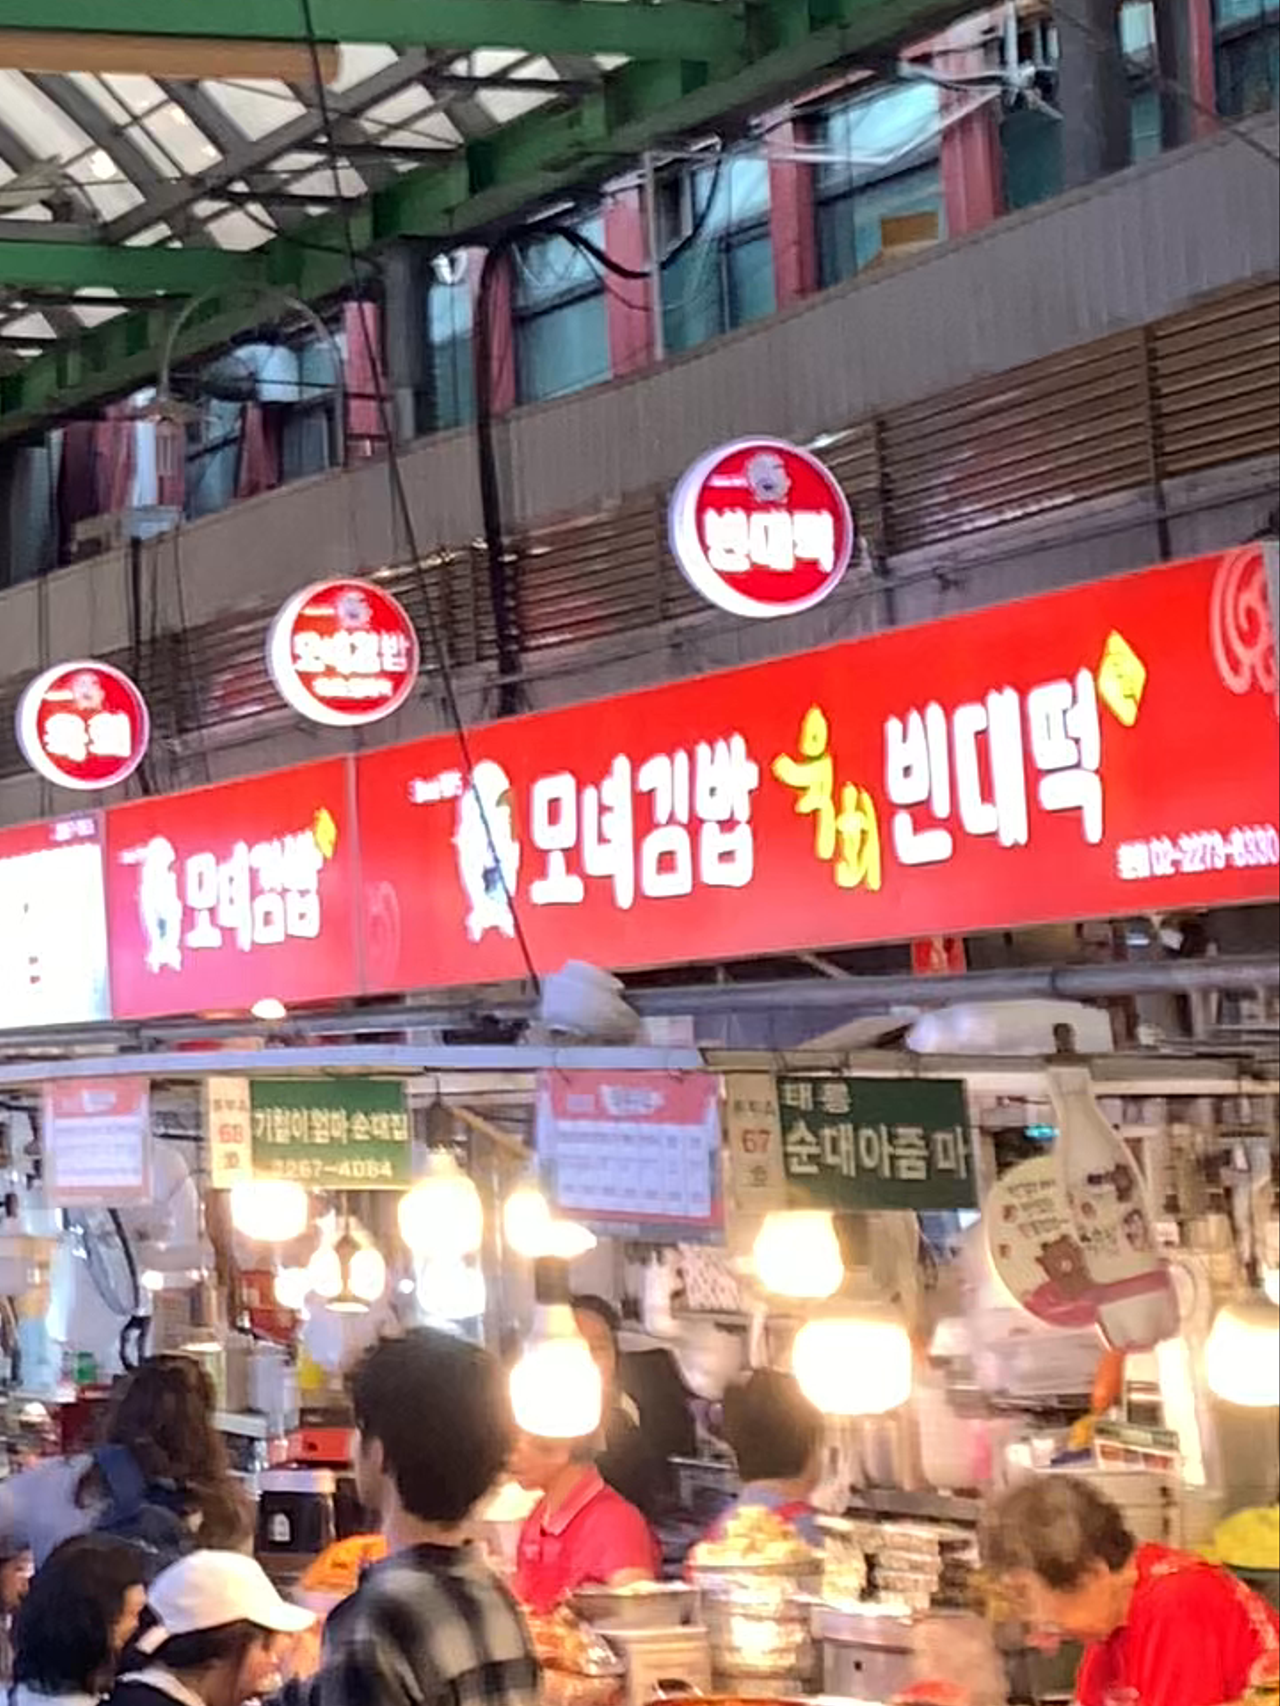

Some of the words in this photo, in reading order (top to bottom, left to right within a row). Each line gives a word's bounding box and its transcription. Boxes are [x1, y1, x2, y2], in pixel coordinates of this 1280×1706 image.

[528, 732, 760, 910] 모녀김밥
[884, 666, 1104, 866] 빈대떡
[184, 830, 324, 952] 모녀김밥
[741, 1128, 771, 1154] 67
